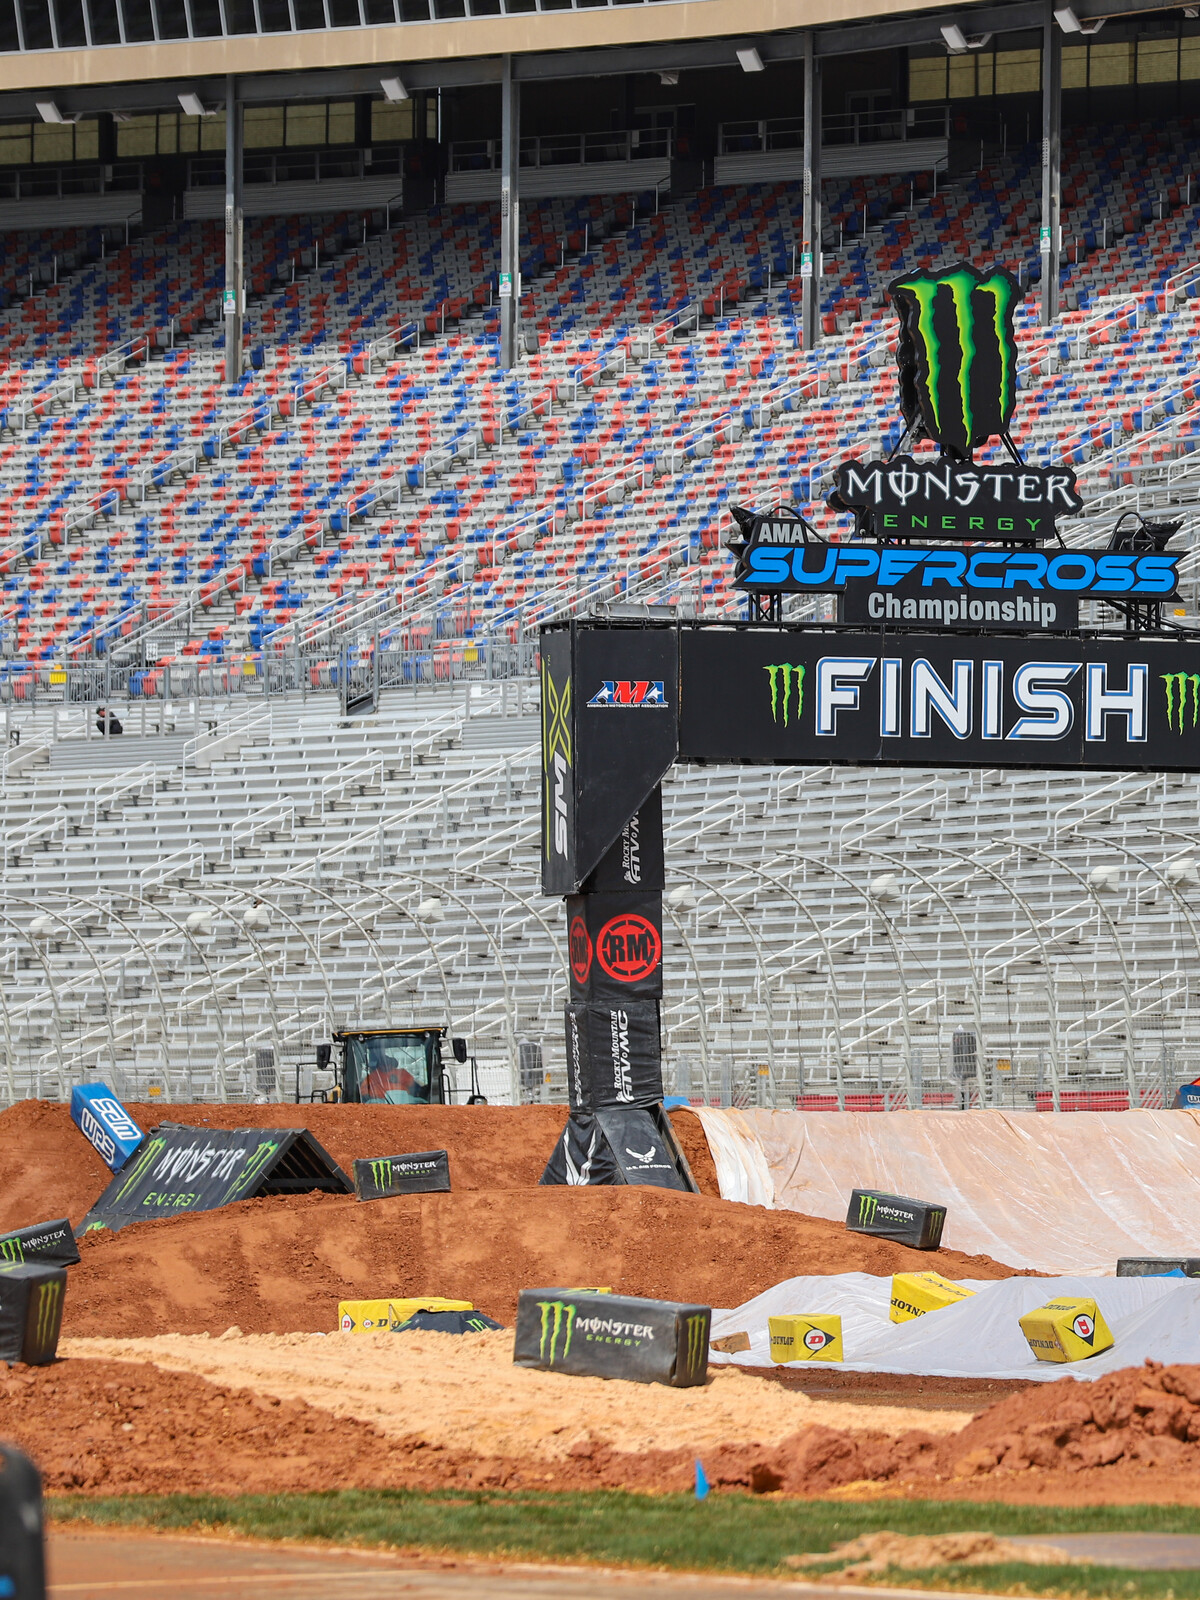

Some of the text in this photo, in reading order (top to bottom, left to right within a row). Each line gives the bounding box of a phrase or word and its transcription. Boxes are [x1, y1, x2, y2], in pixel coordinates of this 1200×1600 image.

[847, 463, 1077, 508] MONSTER
[758, 522, 804, 543] AMA
[884, 514, 1042, 532] ENERGY
[744, 546, 1180, 593] SUPERCROSS
[868, 592, 1057, 628] Championship
[586, 681, 669, 704] AMA
[815, 656, 1149, 742] FINISH
[622, 839, 630, 869] ROCKY
[610, 1010, 622, 1089] ROCKY MOUNTAIN
[392, 1161, 437, 1172] MONSTER
[876, 1205, 914, 1220] MONSTER
[881, 1214, 908, 1223] ENERGY
[22, 1229, 66, 1249] MONSTER
[890, 1297, 927, 1317] UNLOP
[575, 1316, 655, 1340] MONSTER
[586, 1334, 642, 1347] ENERGY
